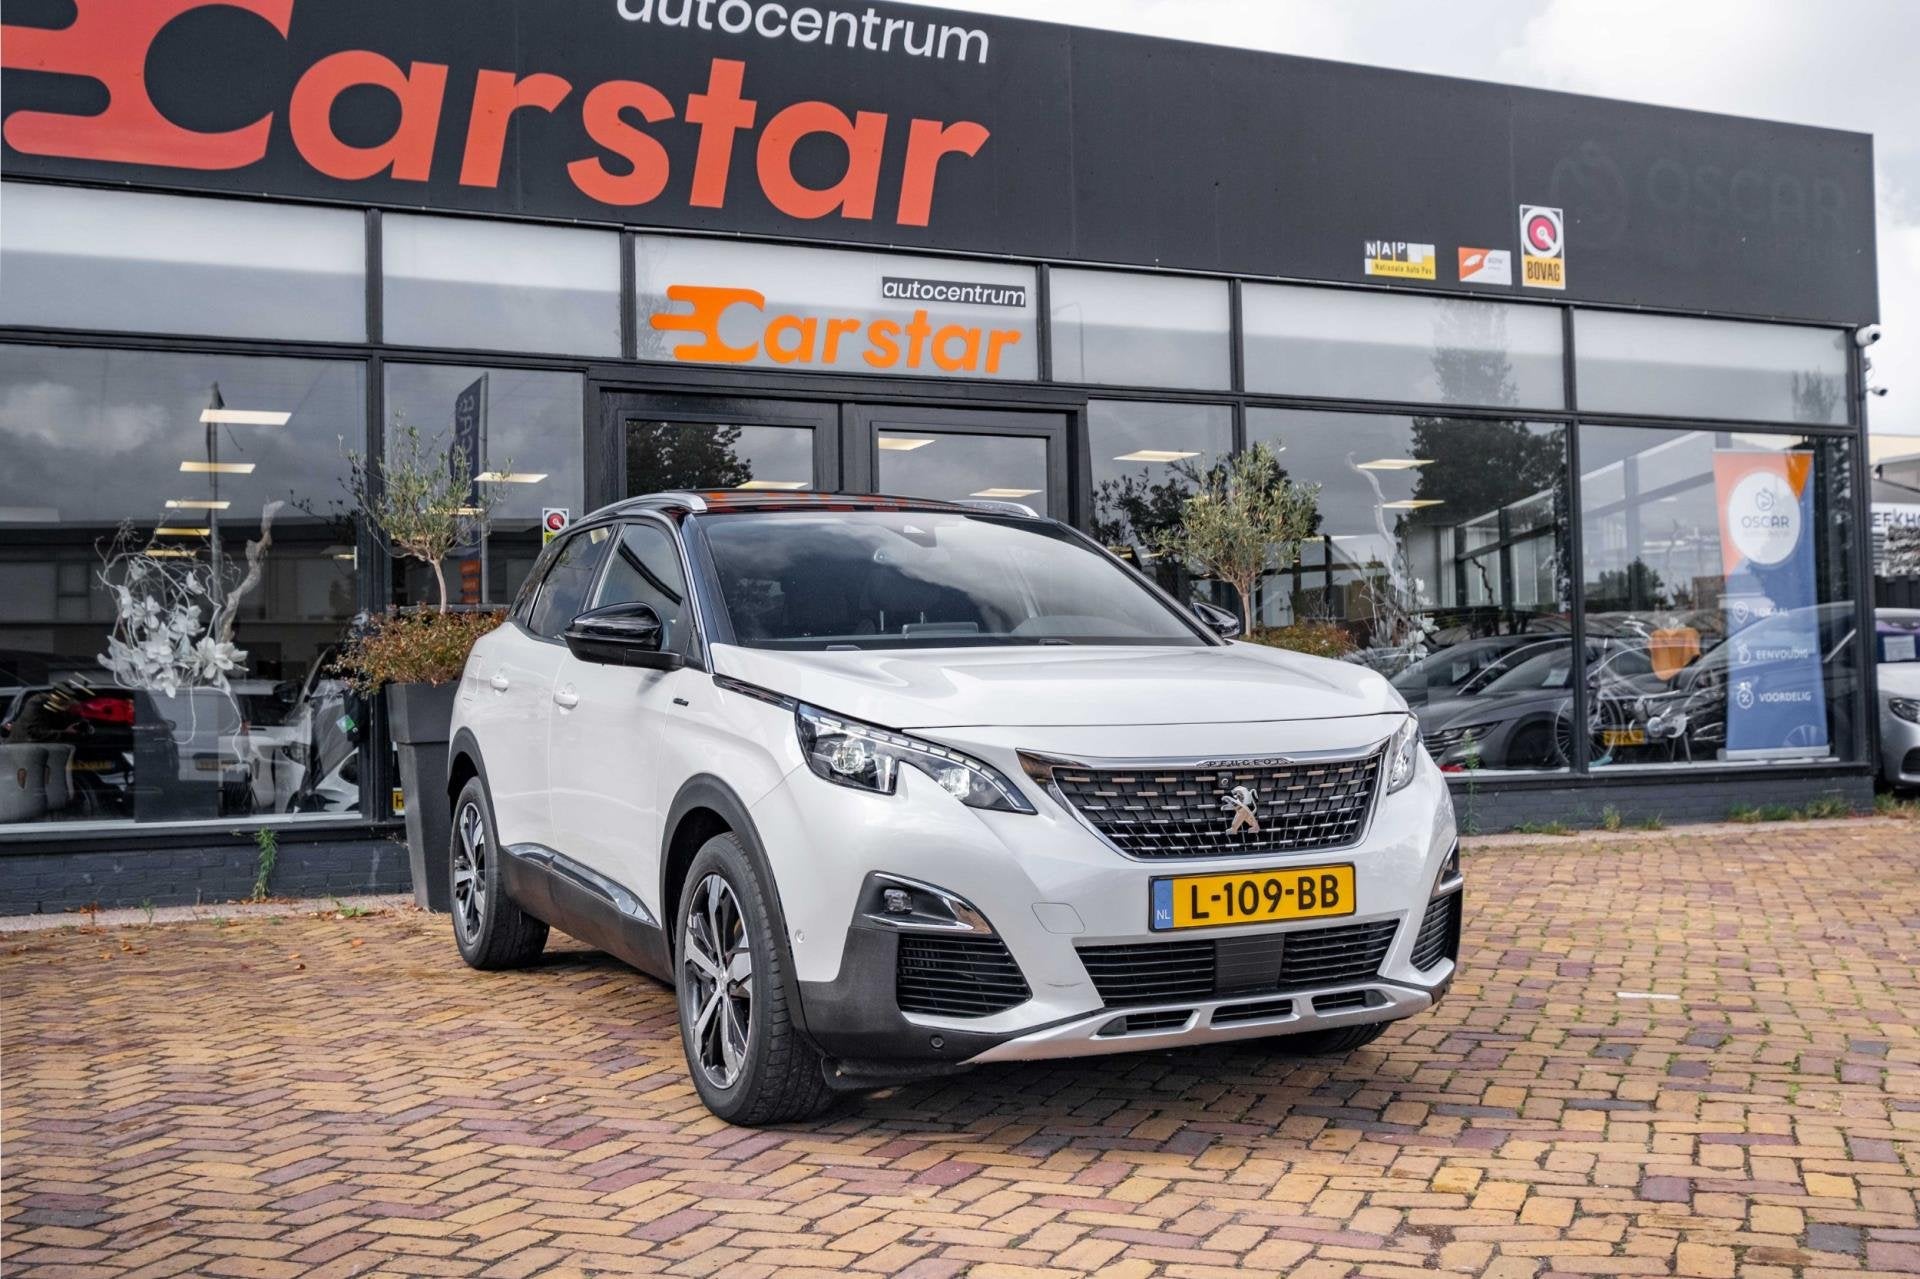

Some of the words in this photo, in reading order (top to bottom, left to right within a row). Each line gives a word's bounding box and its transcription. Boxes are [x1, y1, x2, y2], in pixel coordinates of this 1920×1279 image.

[616, 0, 990, 64] autocentrum
[2, 0, 989, 228] Carstar
[1526, 260, 1561, 282] BOVAG
[883, 281, 1025, 306] autocentrum
[650, 285, 1022, 374] Carstar
[1740, 515, 1790, 528] OSCAR
[1756, 647, 1809, 660] EENVOUDIG
[1759, 691, 1812, 702] VOORDELIG
[1156, 909, 1171, 921] NL
[1191, 874, 1339, 920] L-109-BB
